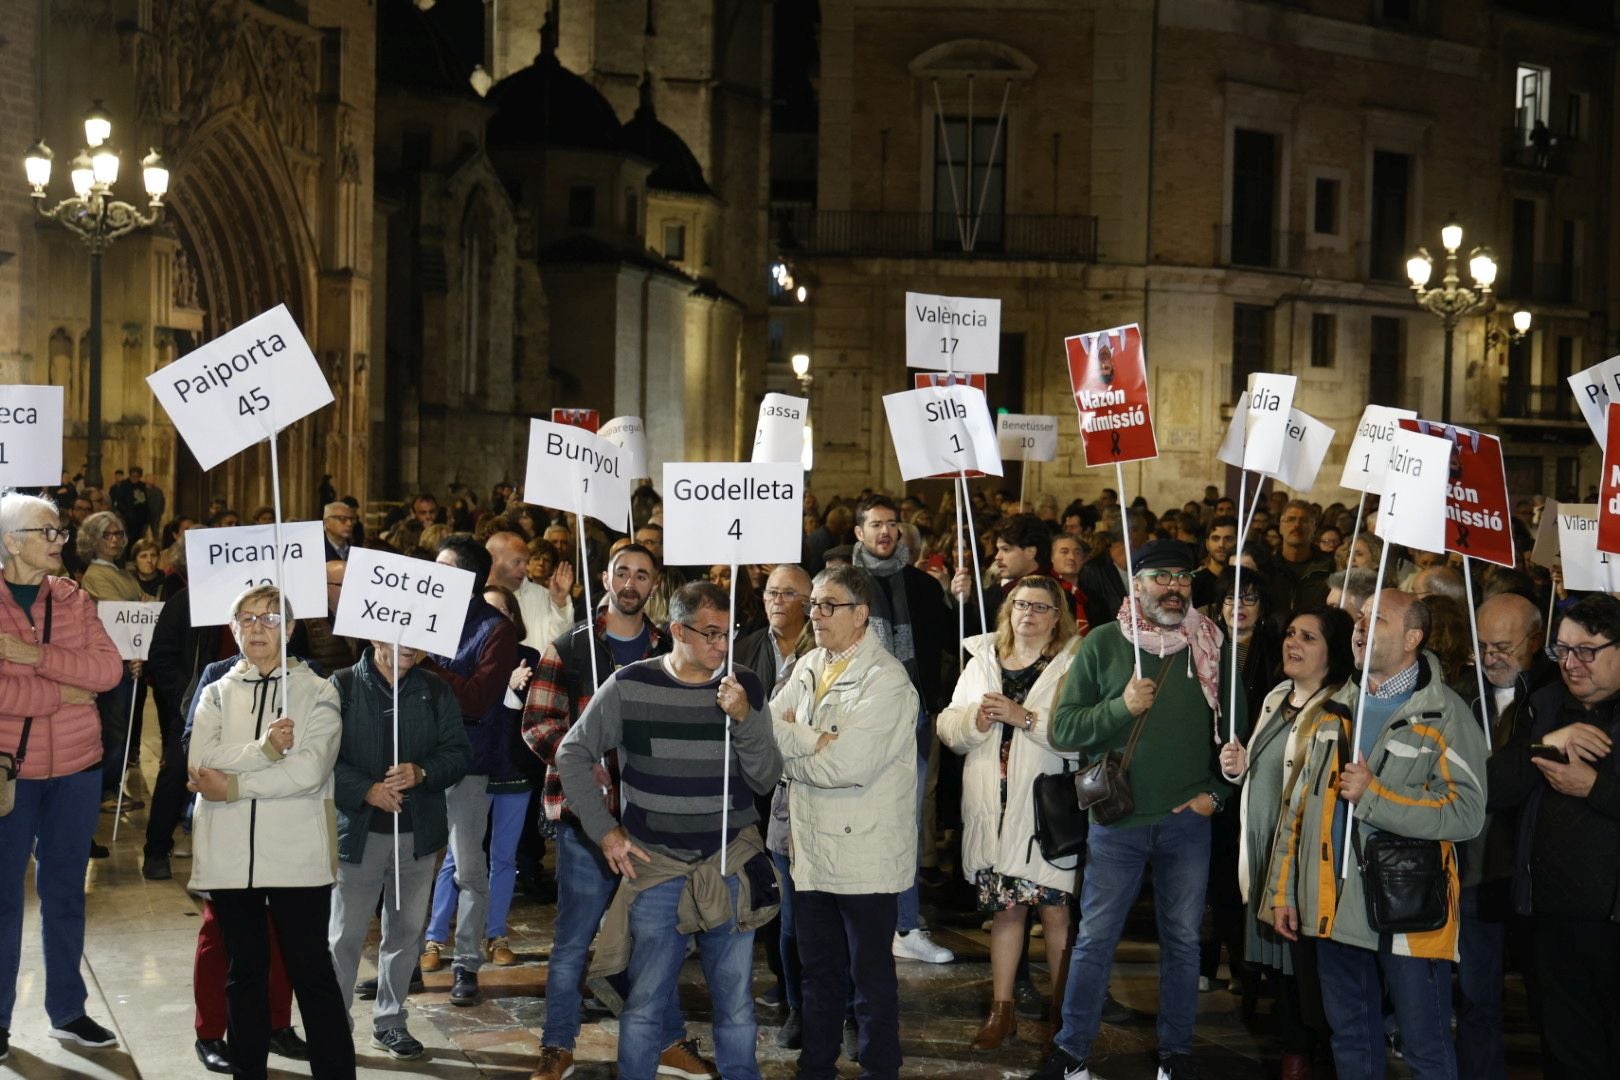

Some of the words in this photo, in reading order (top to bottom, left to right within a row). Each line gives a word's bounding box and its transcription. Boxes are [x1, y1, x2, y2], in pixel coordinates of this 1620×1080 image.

[916, 305, 987, 327] València
[940, 337, 959, 354] 17
[173, 333, 287, 403] Paiporta
[238, 386, 271, 417] 45
[1080, 385, 1125, 410] Mazón
[925, 398, 967, 422] Silla
[950, 433, 965, 453] 1
[1020, 436, 1035, 448] 10
[547, 433, 619, 478] Bunyol
[1362, 453, 1371, 472] 1
[582, 478, 589, 493] 1
[674, 477, 794, 501] Godelleta
[1387, 492, 1396, 516] 1
[727, 518, 743, 540] 4
[370, 565, 410, 592] Sot
[416, 575, 445, 599] de
[361, 599, 412, 626] Xera
[425, 614, 439, 633] 1
[133, 634, 142, 647] 6
